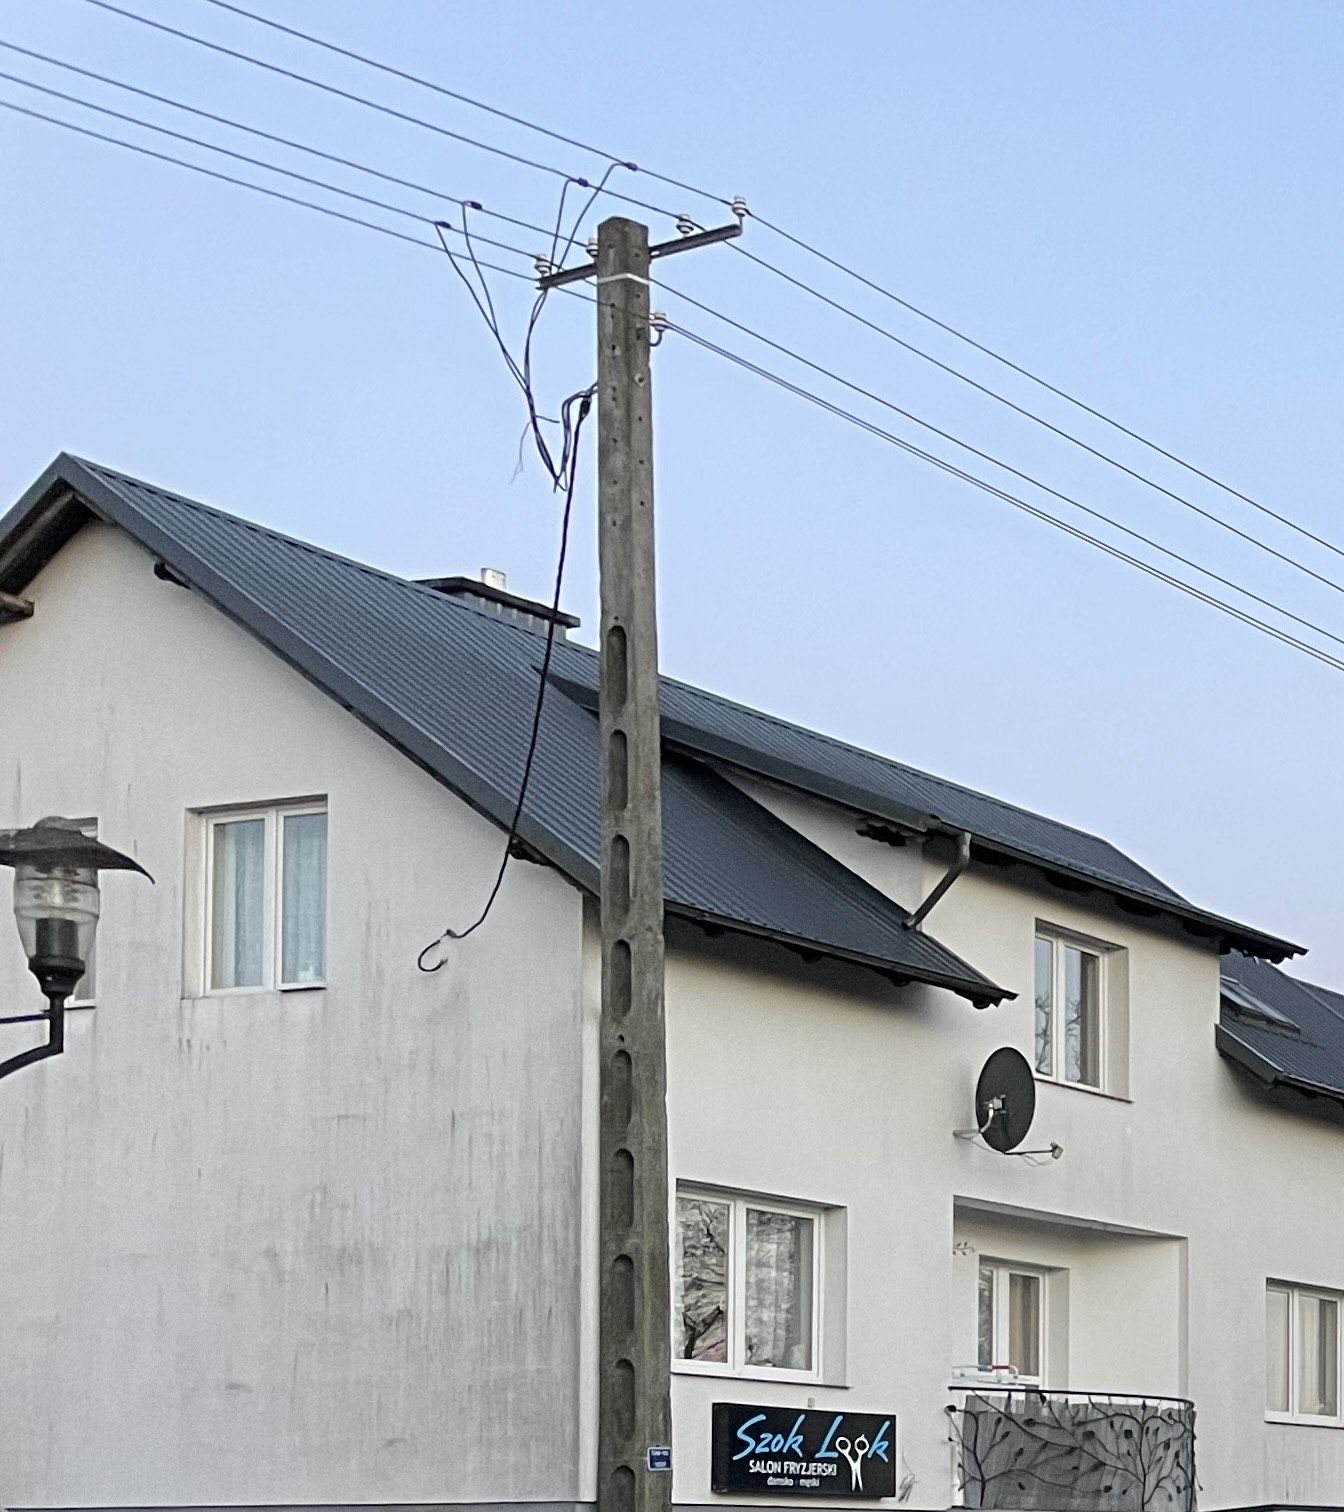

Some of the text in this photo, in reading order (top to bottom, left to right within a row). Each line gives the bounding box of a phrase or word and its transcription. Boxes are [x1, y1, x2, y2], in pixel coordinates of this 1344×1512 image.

[733, 1414, 805, 1460] Szok
[749, 1459, 837, 1477] SALON FRYZJERSKI
